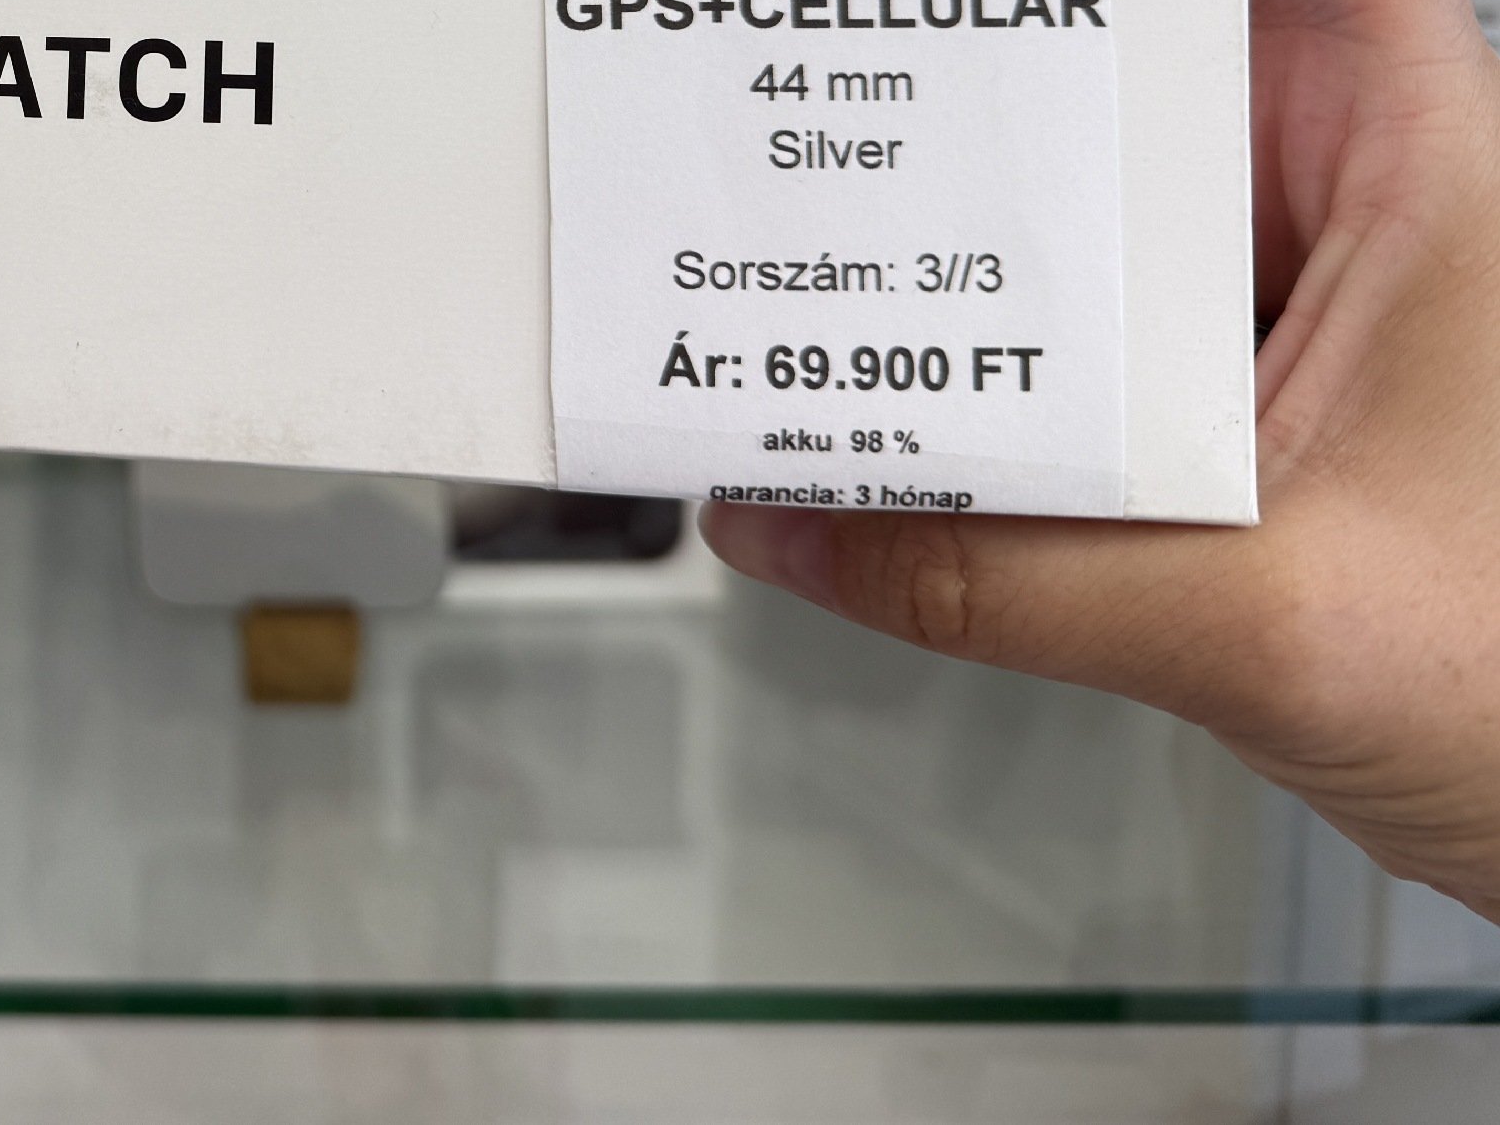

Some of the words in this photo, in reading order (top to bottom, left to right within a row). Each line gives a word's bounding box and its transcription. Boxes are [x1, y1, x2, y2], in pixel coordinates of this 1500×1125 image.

[750, 63, 809, 101] 44
[827, 70, 913, 102] mm
[768, 129, 903, 170] Silver
[673, 250, 895, 292] Sorszám:
[916, 253, 1003, 293] 3//3
[658, 330, 742, 389] Ár:
[765, 344, 950, 392] 69.900
[972, 347, 1044, 392] FT
[763, 428, 832, 452] akku
[850, 429, 884, 454] 98
[893, 430, 920, 455] %
[709, 483, 845, 505] garancia:
[854, 484, 871, 507] 3
[880, 485, 973, 511] hónap
